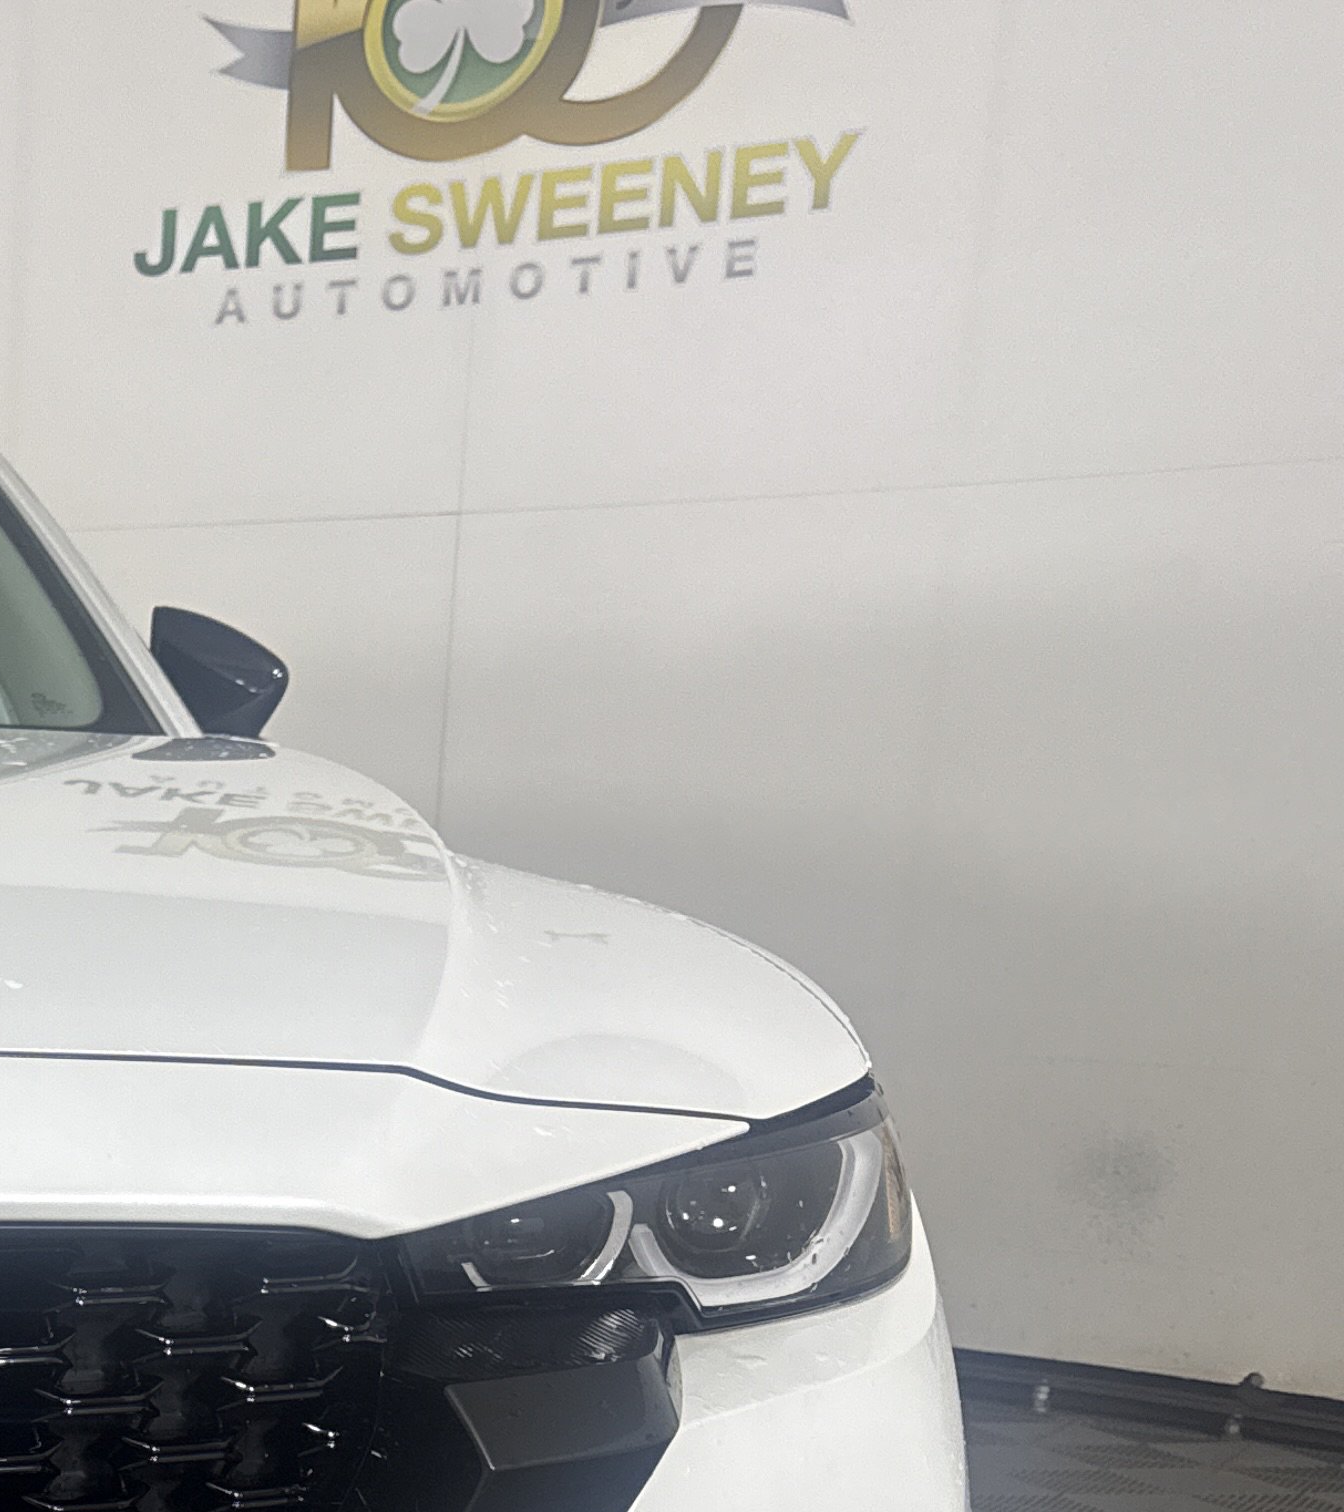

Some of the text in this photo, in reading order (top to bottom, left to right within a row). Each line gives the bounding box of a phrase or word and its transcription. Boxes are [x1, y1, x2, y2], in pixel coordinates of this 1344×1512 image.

[133, 129, 864, 277] JAKE SWEENEY
[214, 239, 759, 326] AUTOMOTIVE
